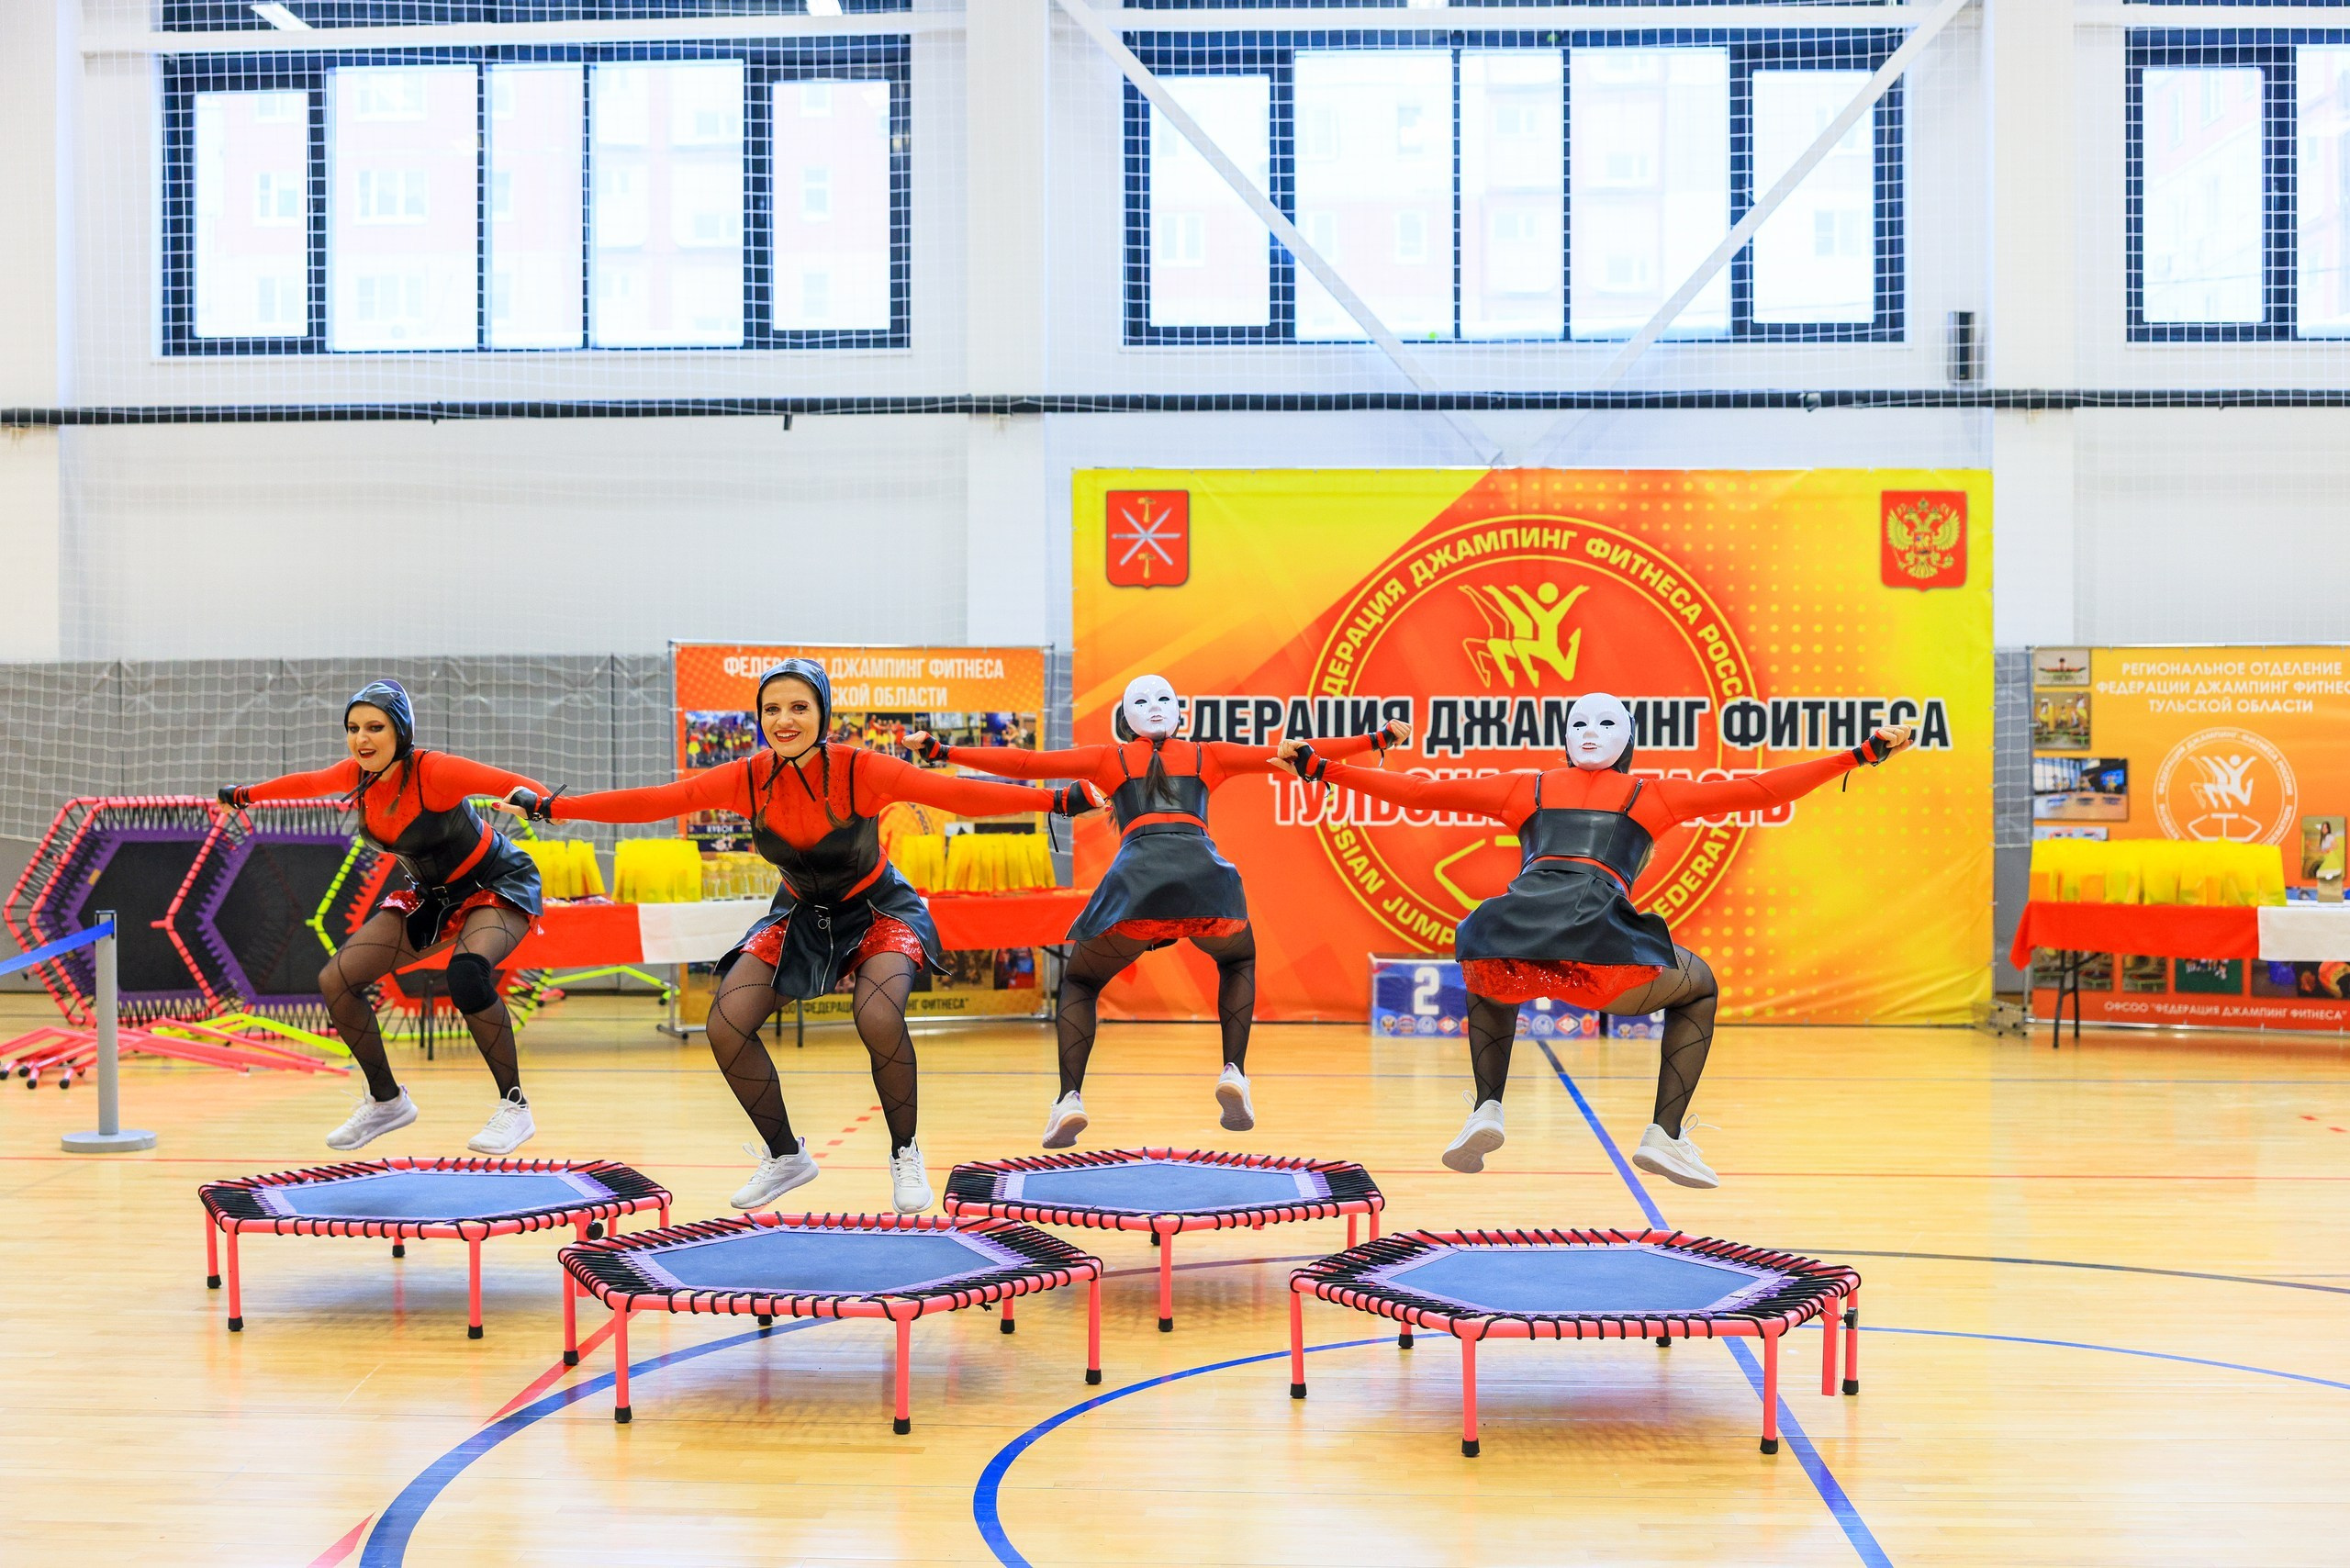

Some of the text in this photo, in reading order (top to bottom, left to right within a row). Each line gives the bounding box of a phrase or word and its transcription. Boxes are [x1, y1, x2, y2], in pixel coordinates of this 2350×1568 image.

[1322, 527, 1745, 703] ДЕРАЦИЯ ДЖАМПИНГ ФИТНЕСА РОСС
[831, 658, 925, 680] ДЖАМПИНГ
[928, 658, 1005, 680] ФИТНЕСА
[2121, 662, 2343, 678] РЕГИОНАЛЬНОЕ ОТДЕЛЕНИЕ
[831, 684, 947, 707] СКОЙ ОБЛАСТИ
[2096, 680, 2350, 695] ФЕДЕРАЦИИ ДЖАМПИНГ ФИТНЕС
[2148, 697, 2314, 713] ТУЛЬСКОЙ ОБЛАСТИ
[1424, 697, 1710, 757] ДЖАМИНГ
[1382, 896, 1456, 946] JUMP
[1639, 825, 1731, 920] EDERAT
[1414, 966, 1440, 1016] 2
[2221, 1005, 2288, 1019] ДЖАМПИНГ
